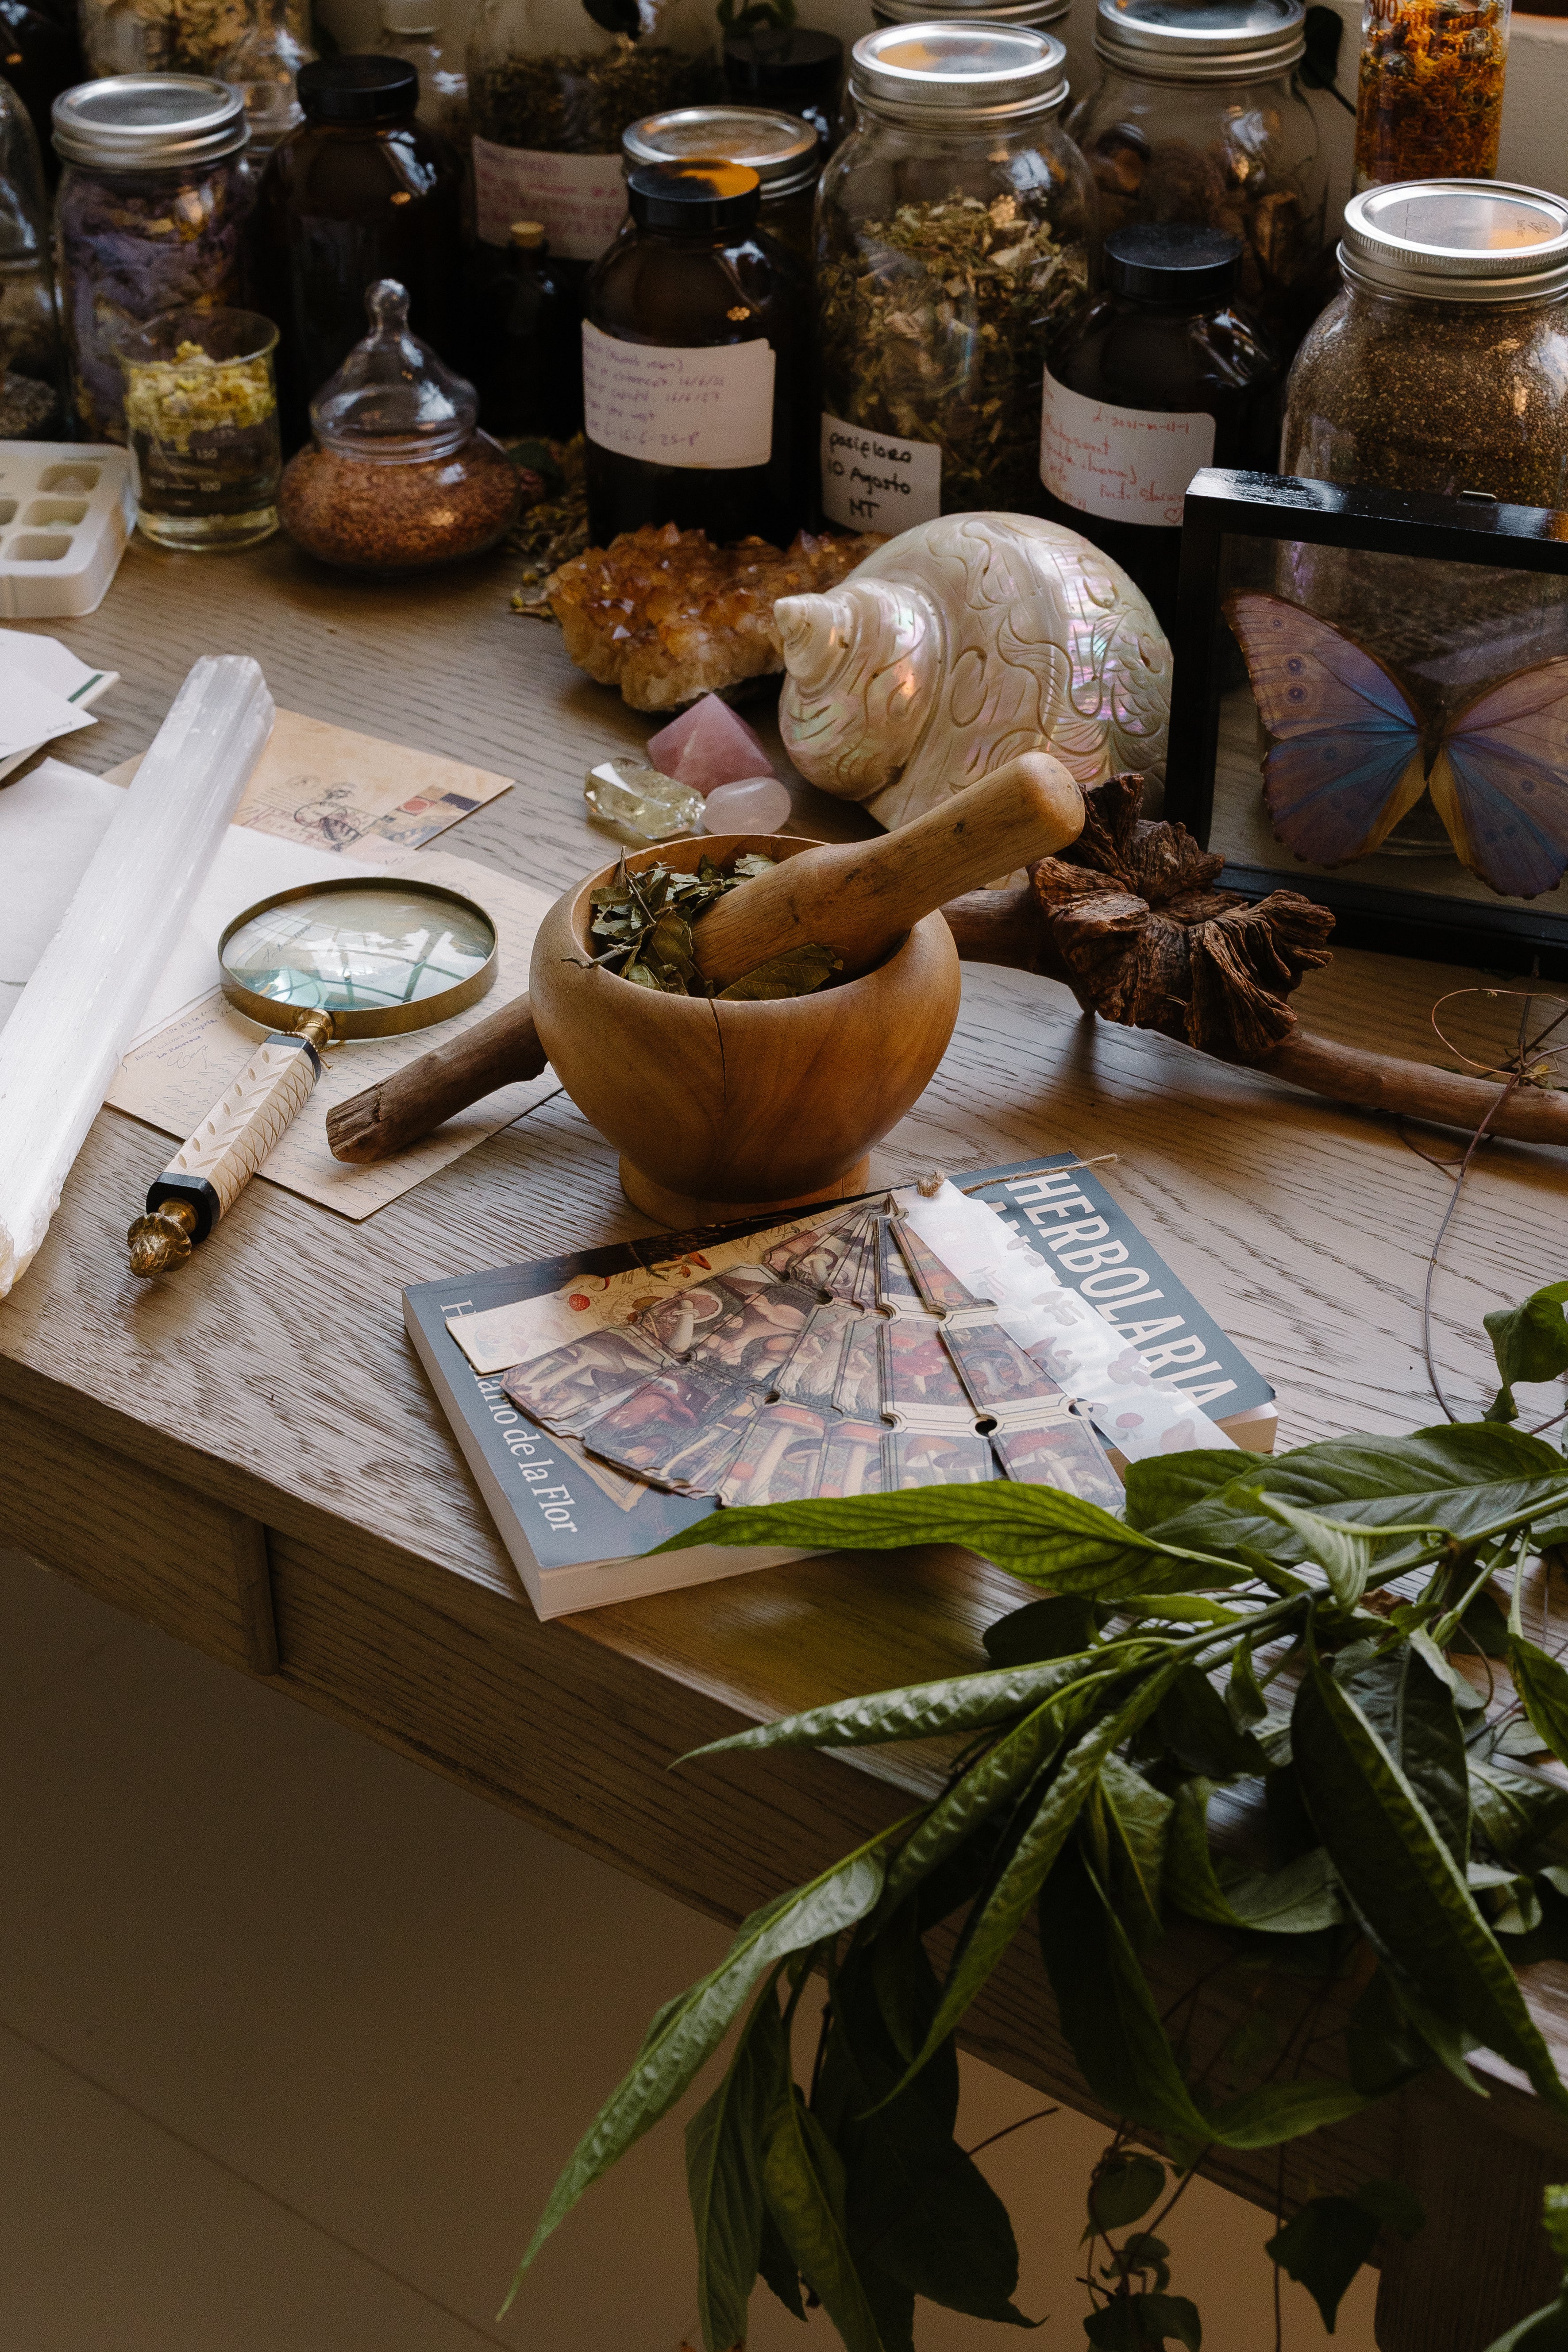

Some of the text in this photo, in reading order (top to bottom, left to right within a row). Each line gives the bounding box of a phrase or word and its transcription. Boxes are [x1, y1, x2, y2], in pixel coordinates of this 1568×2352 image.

[1005, 1171, 1238, 1407] HERBOLARIA
[503, 1429, 542, 1456] de
[518, 1458, 555, 1483] la
[531, 1484, 578, 1533] Flor
